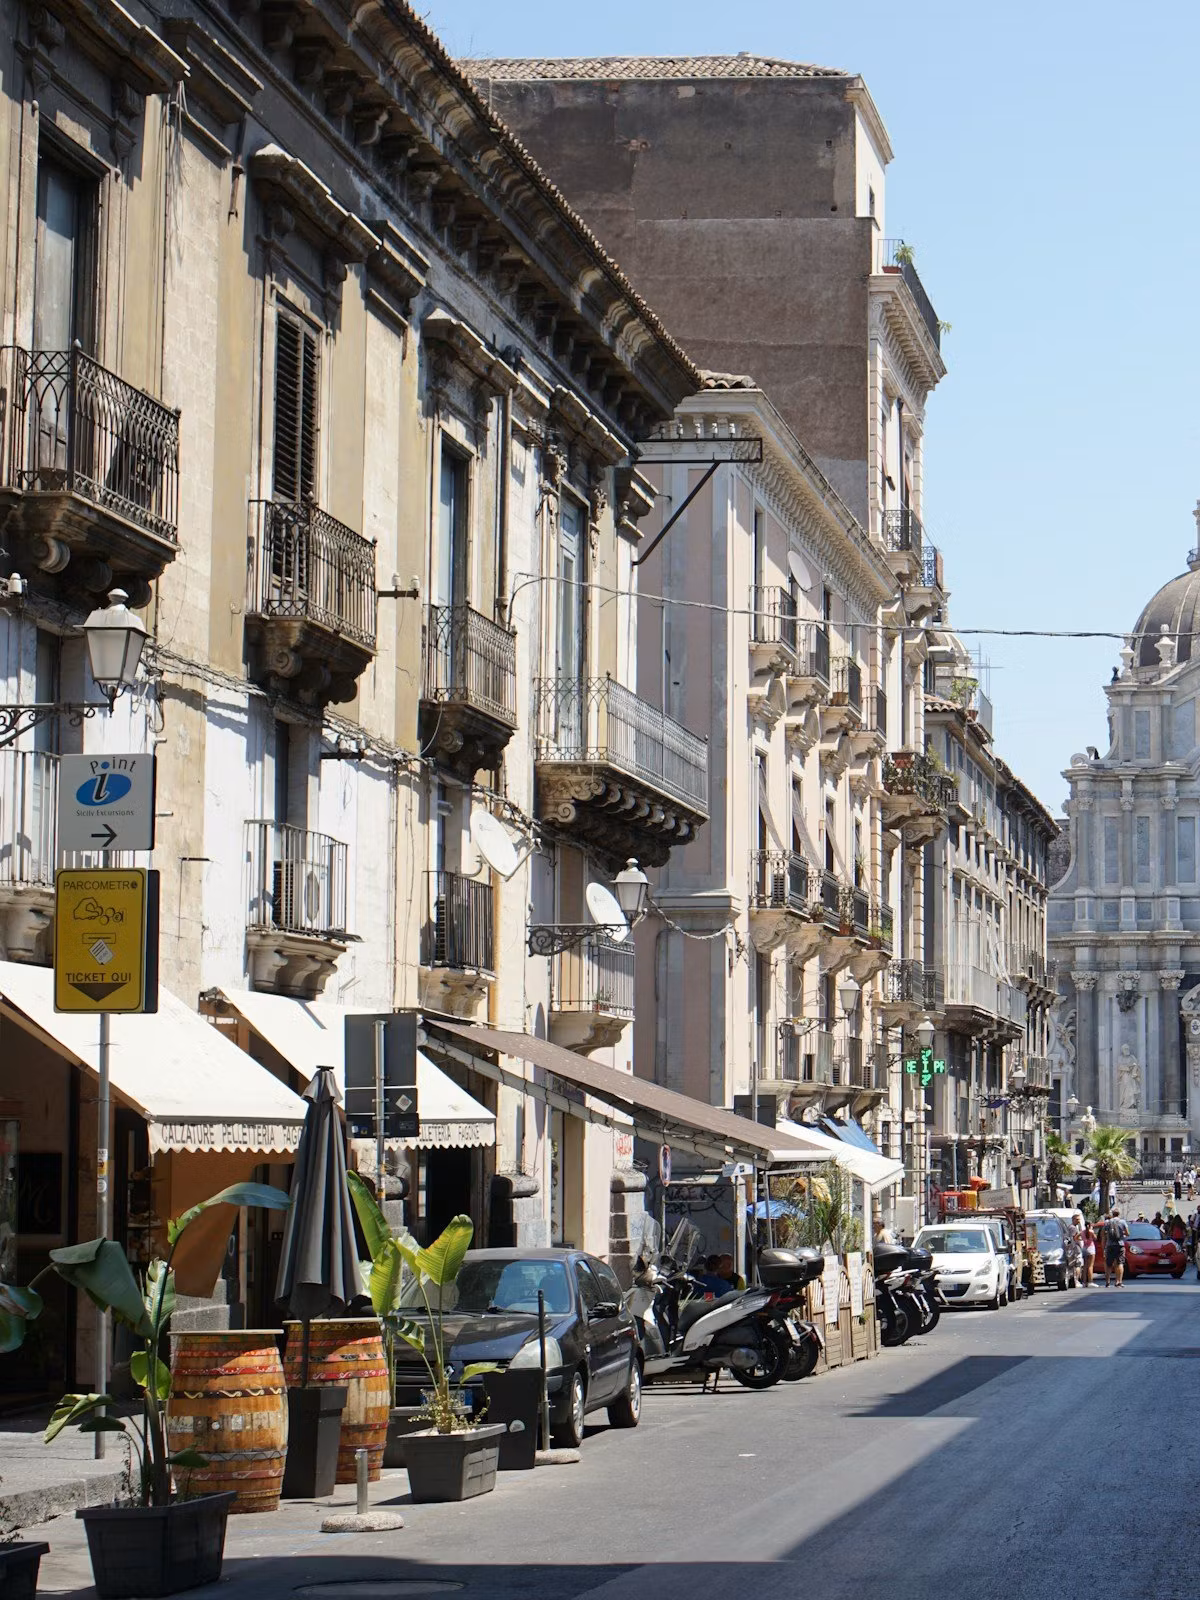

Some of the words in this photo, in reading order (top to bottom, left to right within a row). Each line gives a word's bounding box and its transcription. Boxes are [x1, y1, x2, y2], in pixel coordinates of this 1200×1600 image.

[65, 972, 106, 983] TICKET
[111, 972, 131, 983] QUI
[161, 1124, 214, 1144] CALZATURE
[222, 1124, 275, 1145] PELLETTERIA
